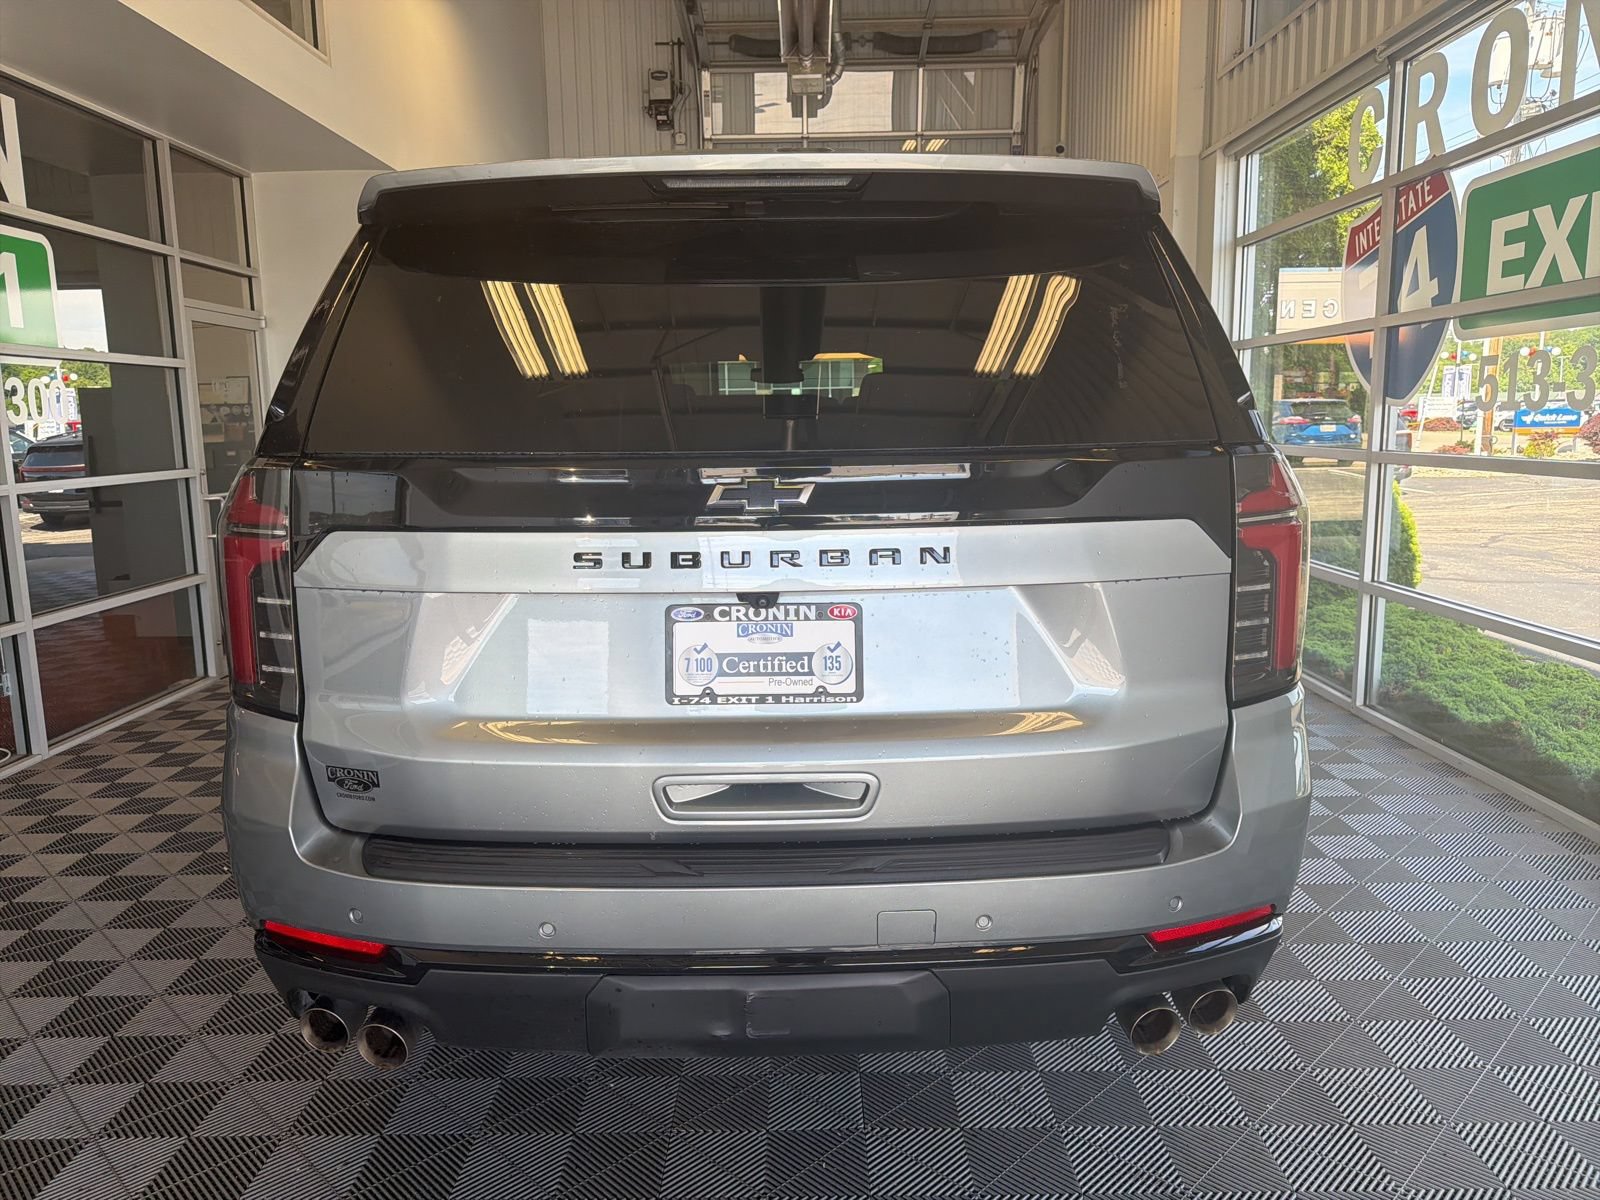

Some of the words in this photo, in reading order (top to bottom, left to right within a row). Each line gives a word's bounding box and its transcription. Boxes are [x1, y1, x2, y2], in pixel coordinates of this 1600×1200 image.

[1355, 176, 1433, 257] INTETATE
[572, 546, 951, 570] SUBURBAN
[713, 605, 816, 621] CRONIN
[832, 608, 853, 617] KIA
[738, 623, 792, 637] CRONIN
[694, 657, 713, 673] 100
[722, 656, 810, 674] Certified
[822, 655, 842, 671] 135
[768, 677, 814, 687] Pre-Owned
[672, 696, 712, 705] I-74
[717, 696, 760, 704] EXIT
[765, 696, 775, 704] 1
[781, 695, 858, 704] Harrison
[327, 766, 379, 785] CRONIN
